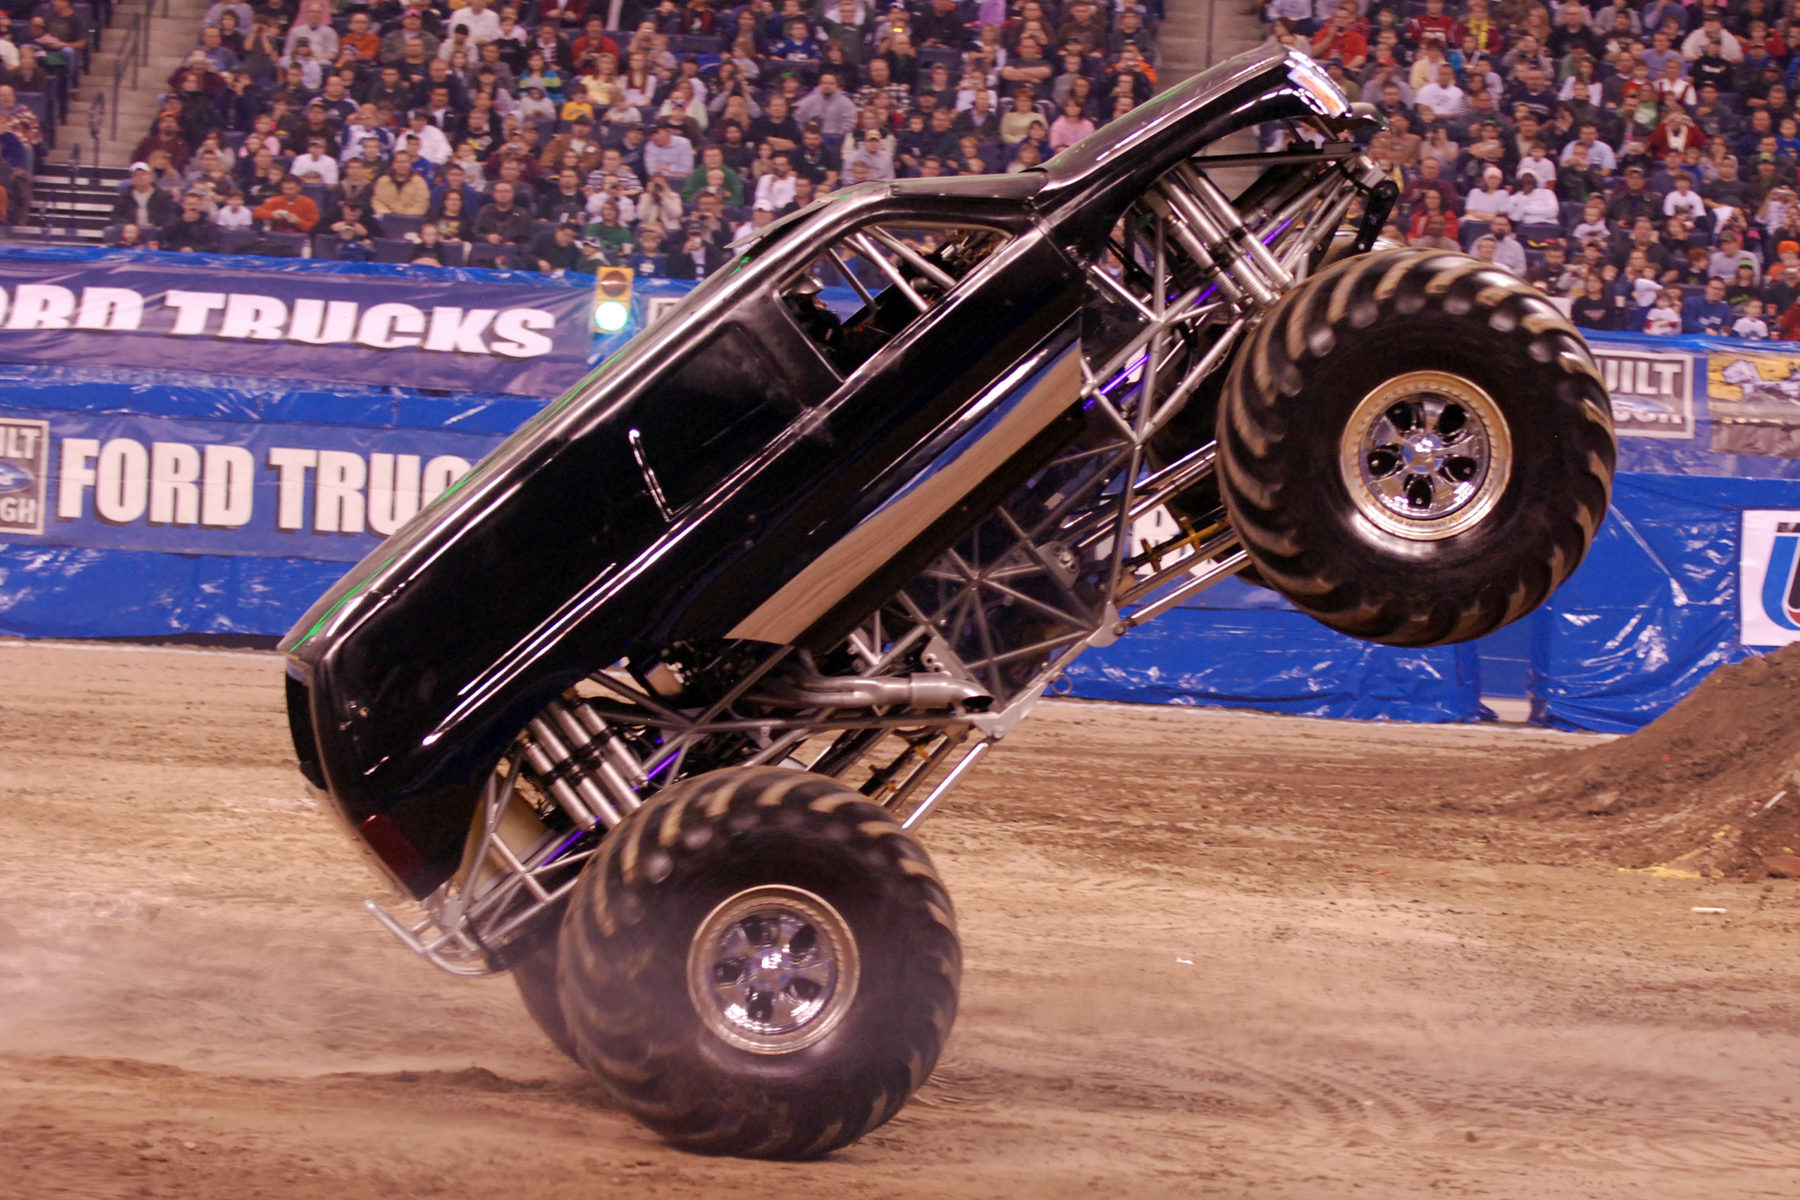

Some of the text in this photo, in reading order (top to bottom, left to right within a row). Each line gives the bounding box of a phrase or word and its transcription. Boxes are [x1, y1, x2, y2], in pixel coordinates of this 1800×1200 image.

[0, 283, 555, 358] RD TRUCKS
[58, 437, 254, 528] FORD
